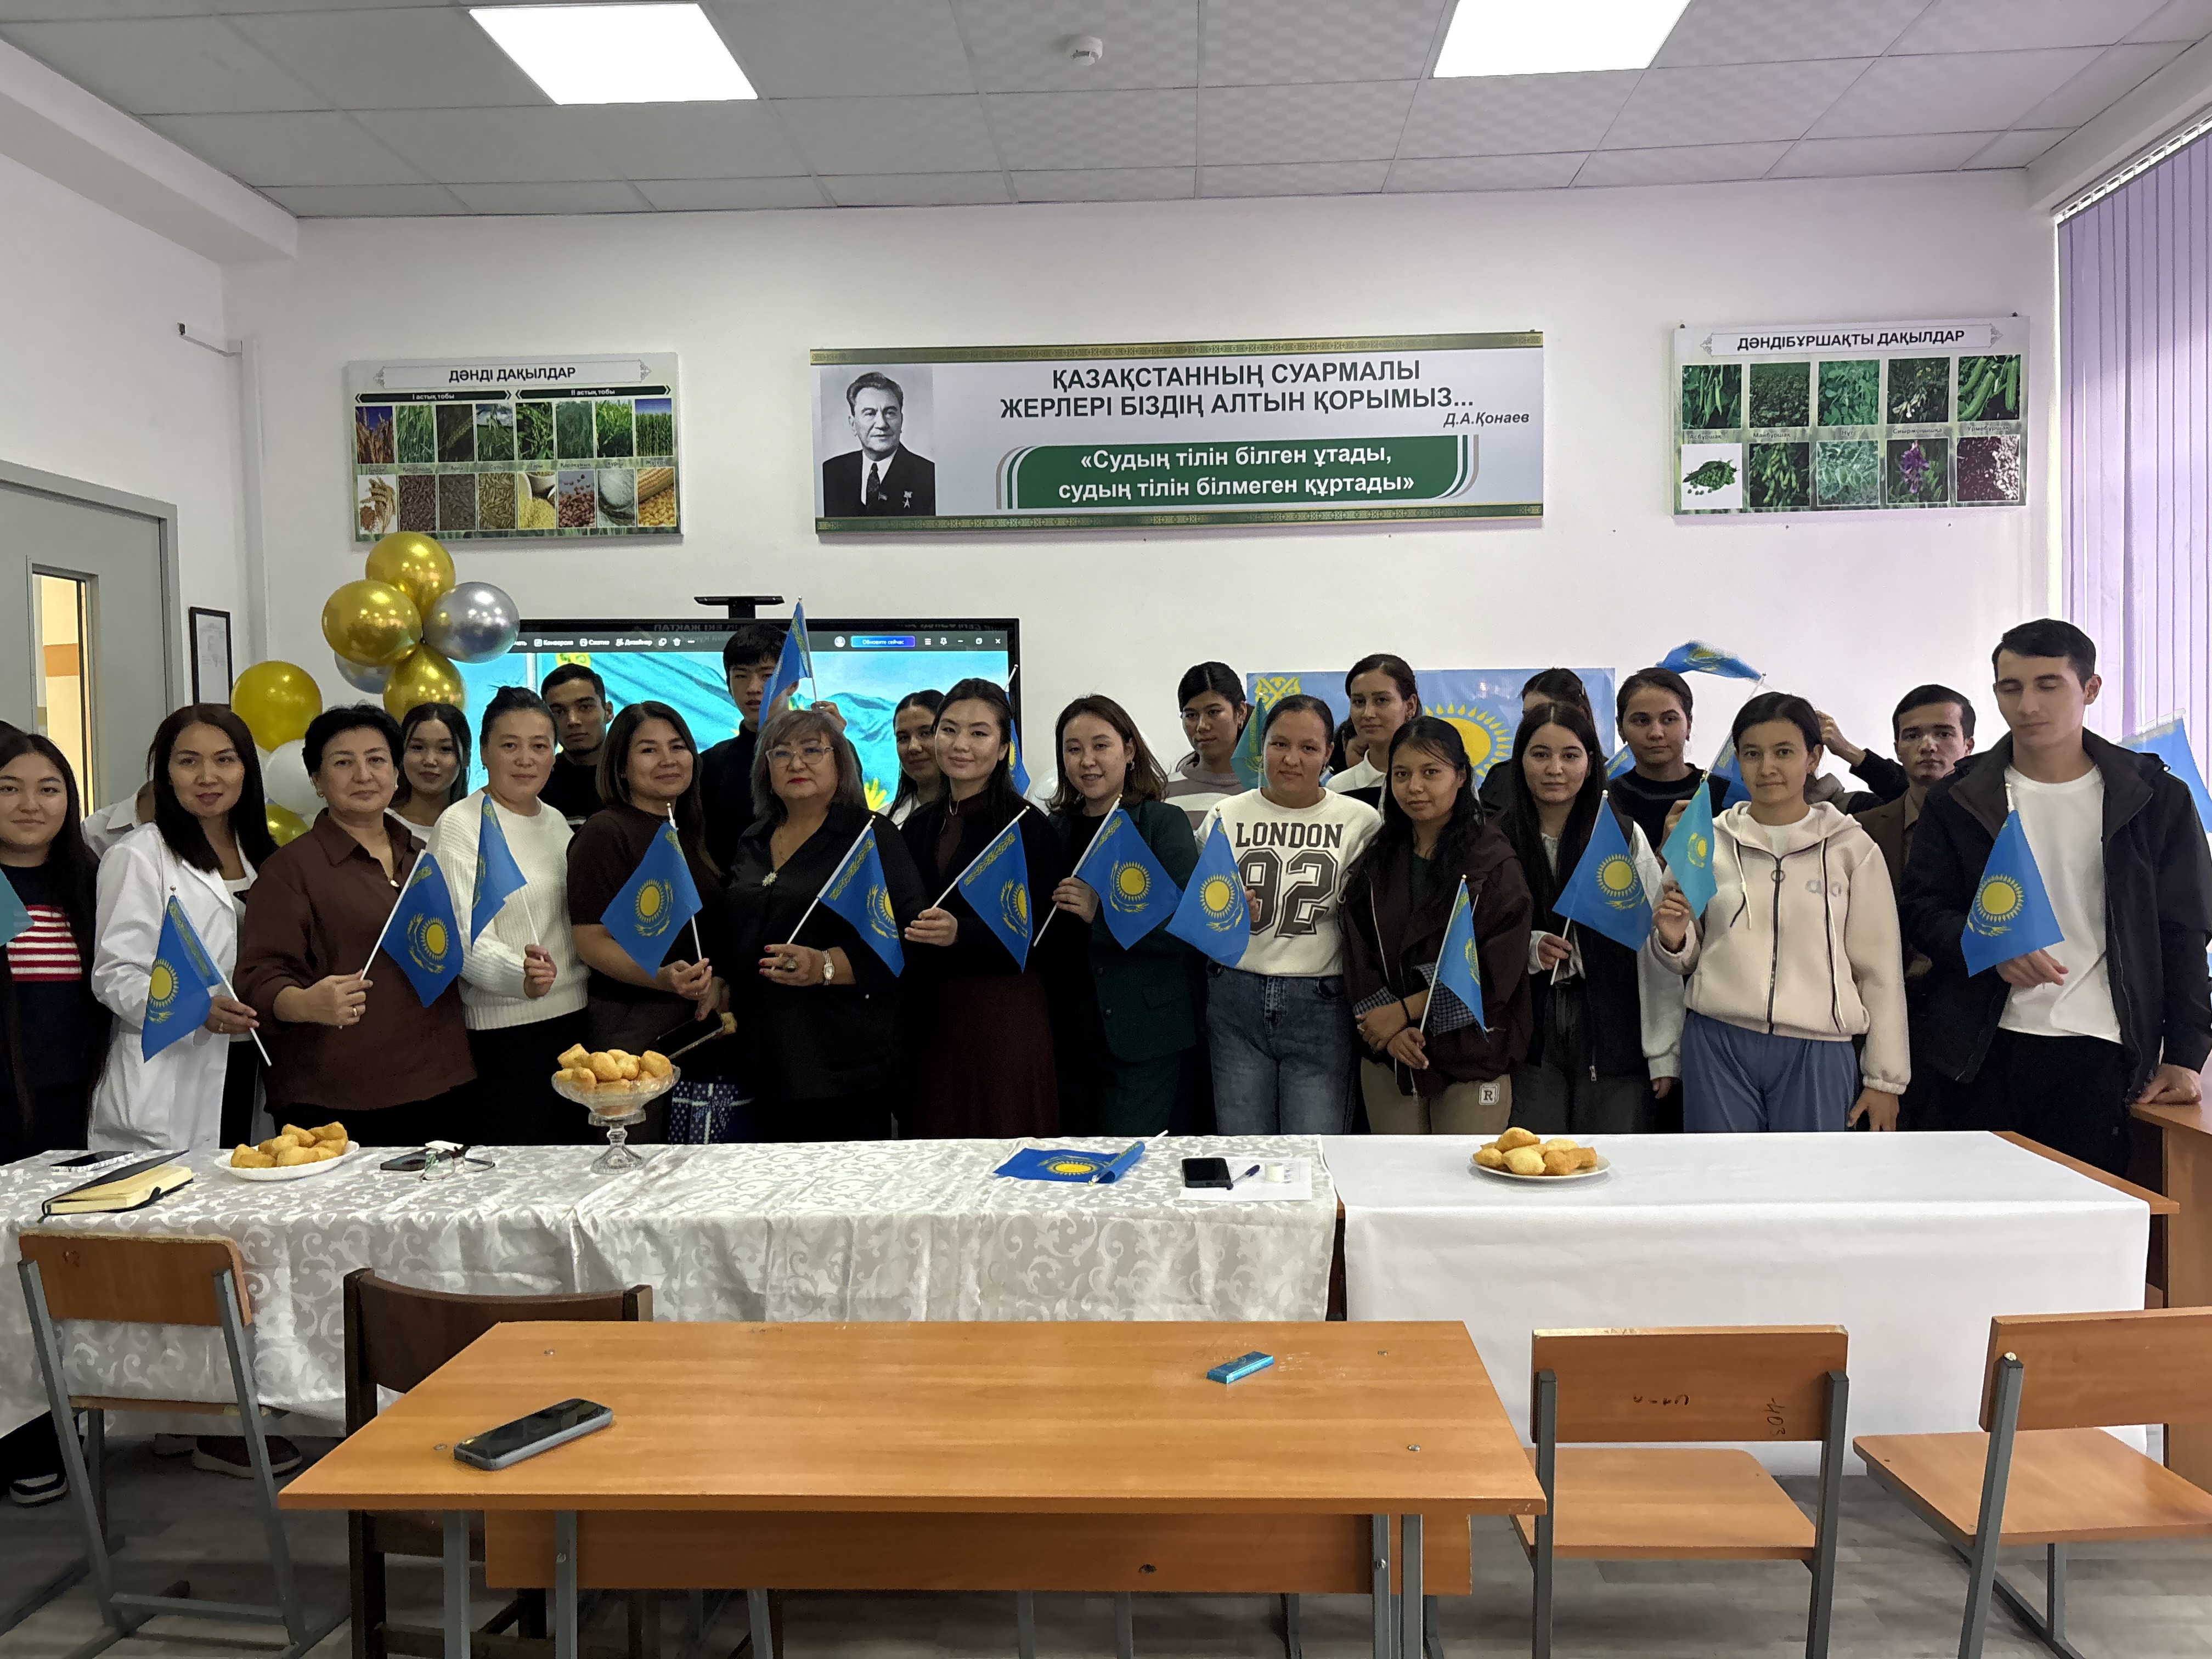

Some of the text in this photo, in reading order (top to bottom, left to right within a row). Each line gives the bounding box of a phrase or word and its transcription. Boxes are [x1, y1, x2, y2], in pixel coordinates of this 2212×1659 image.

[1737, 330, 1965, 351] ДӘНДІБҰРШАҚТЫ ДАҚЫЛДАР
[449, 367, 576, 383] ДӘНДІ ДАҚЫЛДАР
[1052, 360, 1420, 393] ҚАЗАҚСТАННЫҢ СУАРМАЛЫ
[1000, 387, 1474, 419] ЖЕРЛЕРІ БІЗДІҢ АЛТЫН ҚОРЫМЫЗ...
[1443, 412, 1530, 428] Д.А.Қонаев
[1080, 446, 1391, 473] «Судың тілін білген ұтады,
[1059, 476, 1414, 503] судың тілін білмеген құртады»
[1235, 822, 1344, 849] LONDON
[1237, 847, 1339, 939] 92
[1483, 1090, 1493, 1102] R
